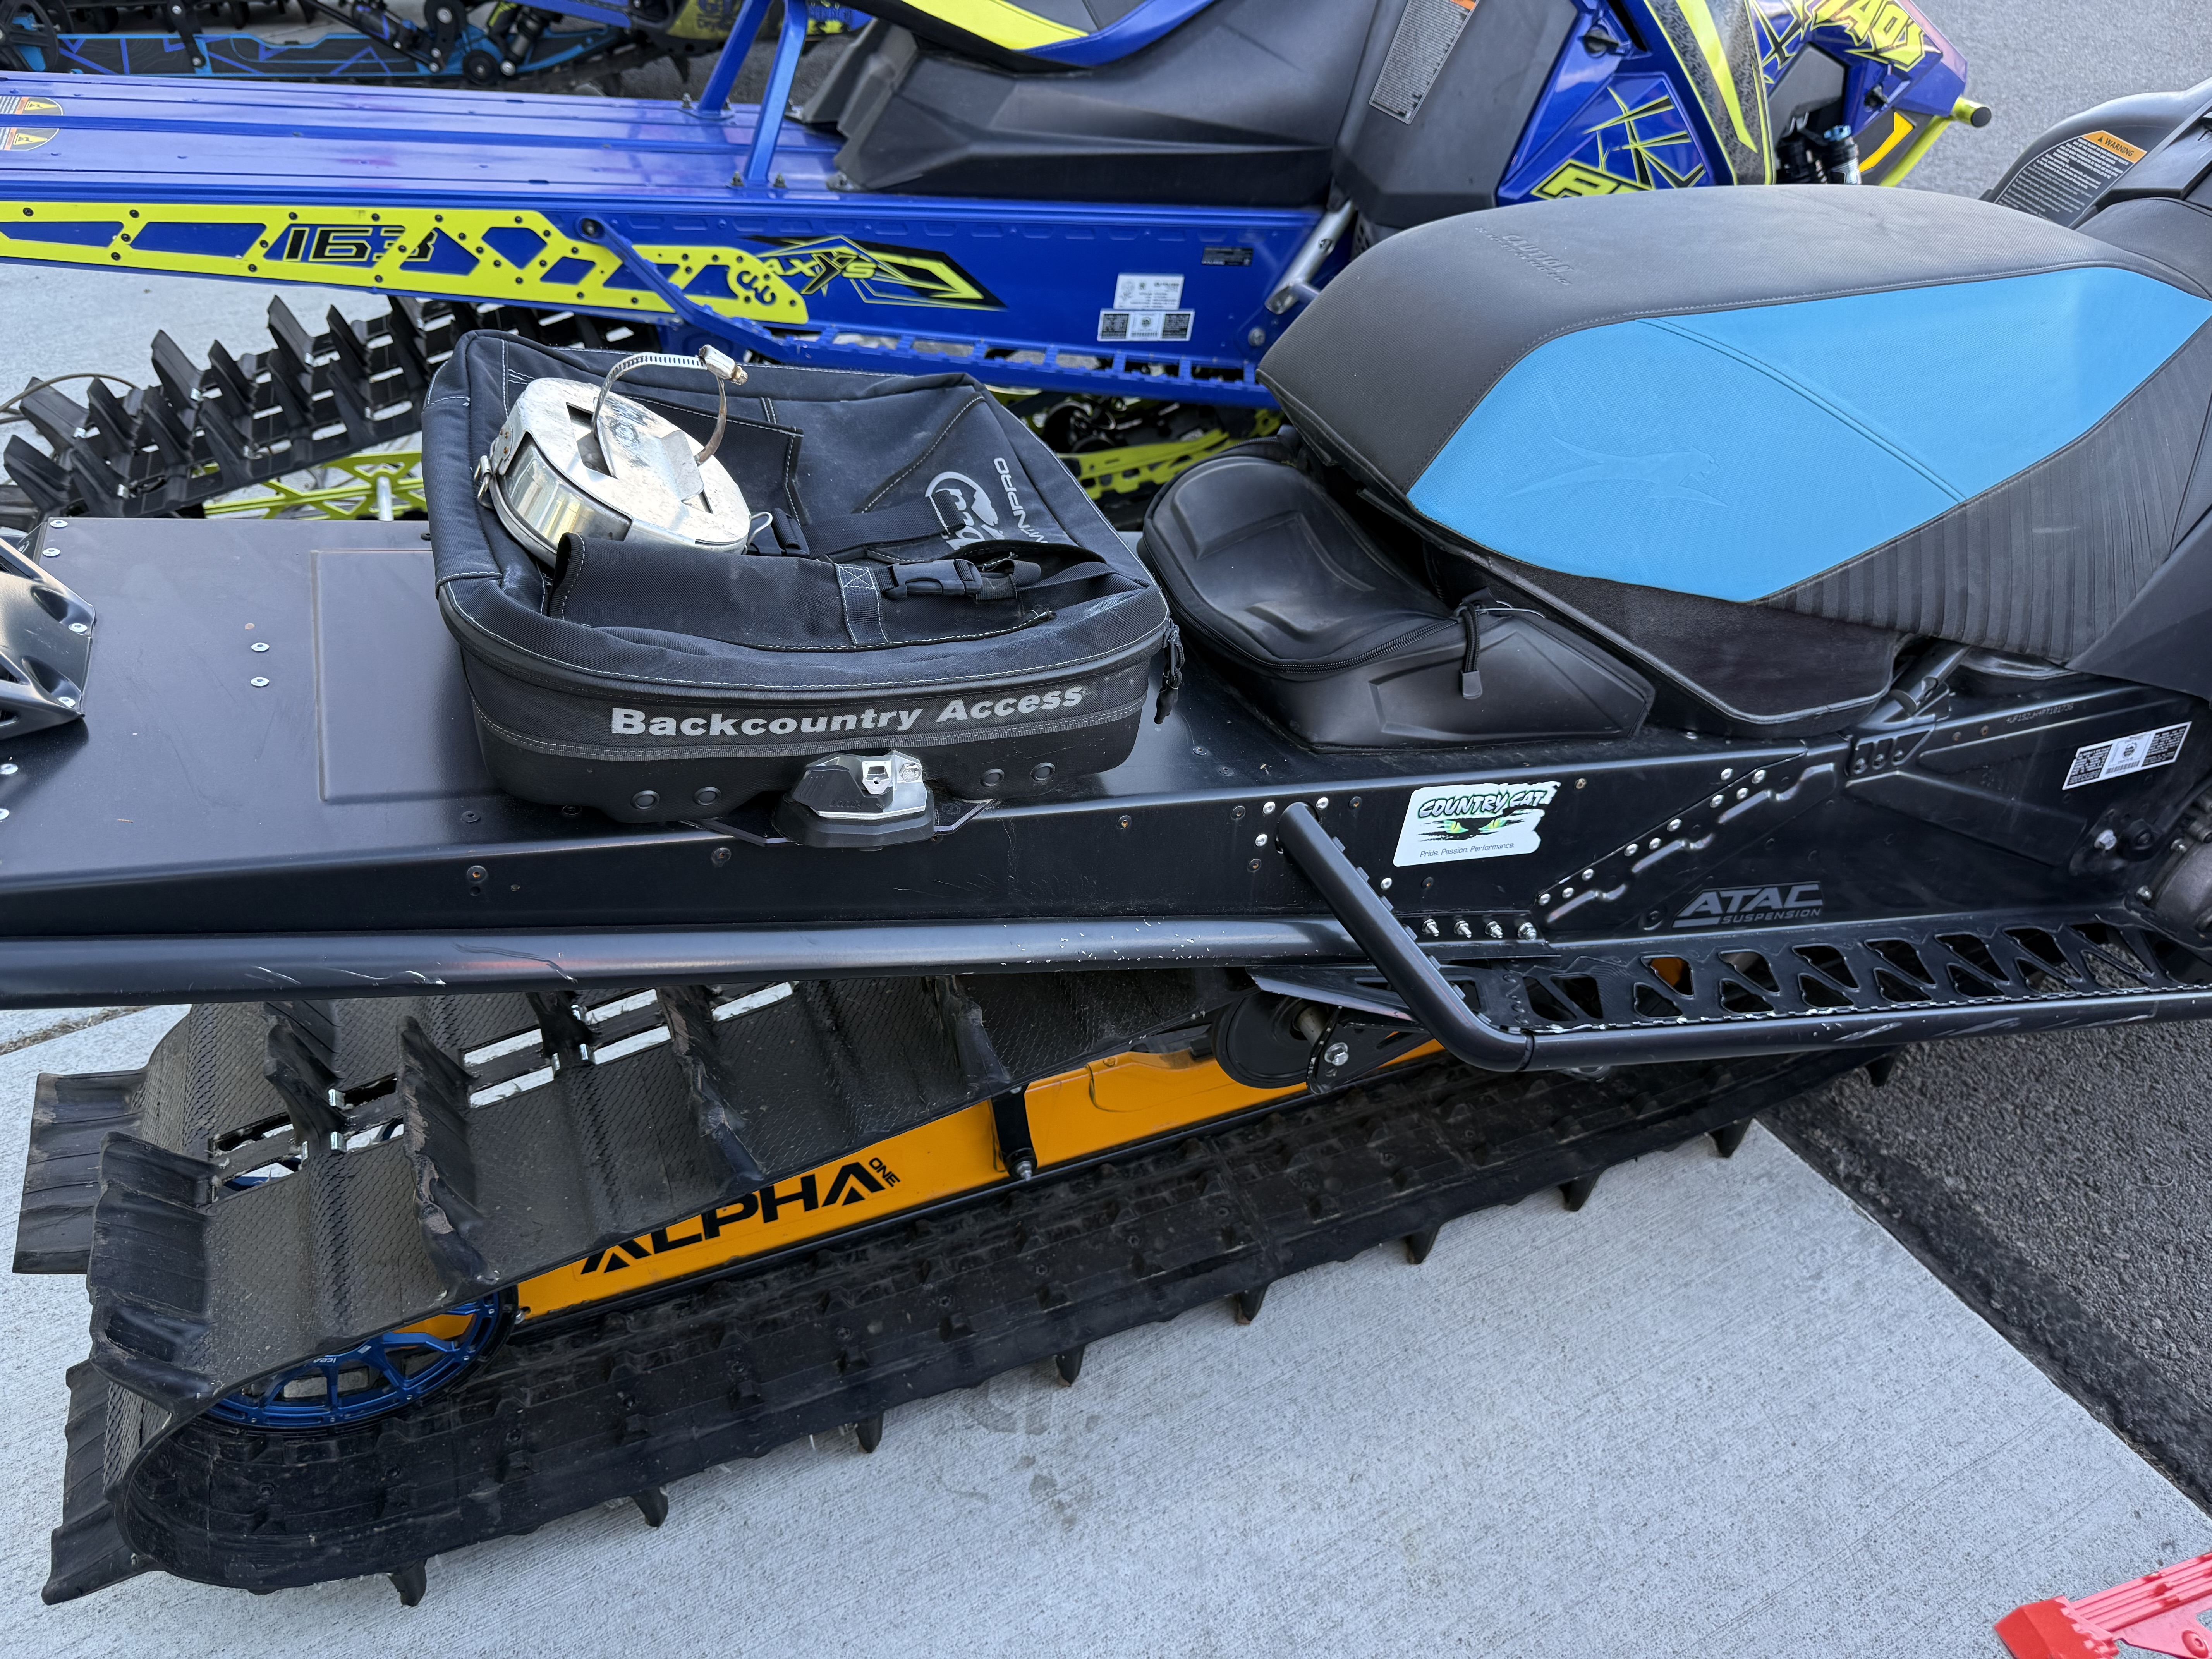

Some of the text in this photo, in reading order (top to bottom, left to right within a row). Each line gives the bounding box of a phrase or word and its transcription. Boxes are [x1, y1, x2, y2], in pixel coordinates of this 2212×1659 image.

[2105, 138, 2134, 157] WARNING
[1503, 235, 1574, 272] CAUTION
[611, 685, 1085, 736] Backcountry Access
[1419, 790, 1548, 818] COUNTRY CAT
[1441, 847, 1468, 855] Passion.
[1470, 842, 1515, 852] Performance.
[1677, 884, 1823, 917] ATAC
[1721, 908, 1821, 924] SUSPENSION
[580, 1157, 901, 1275] ALPHA ONE
